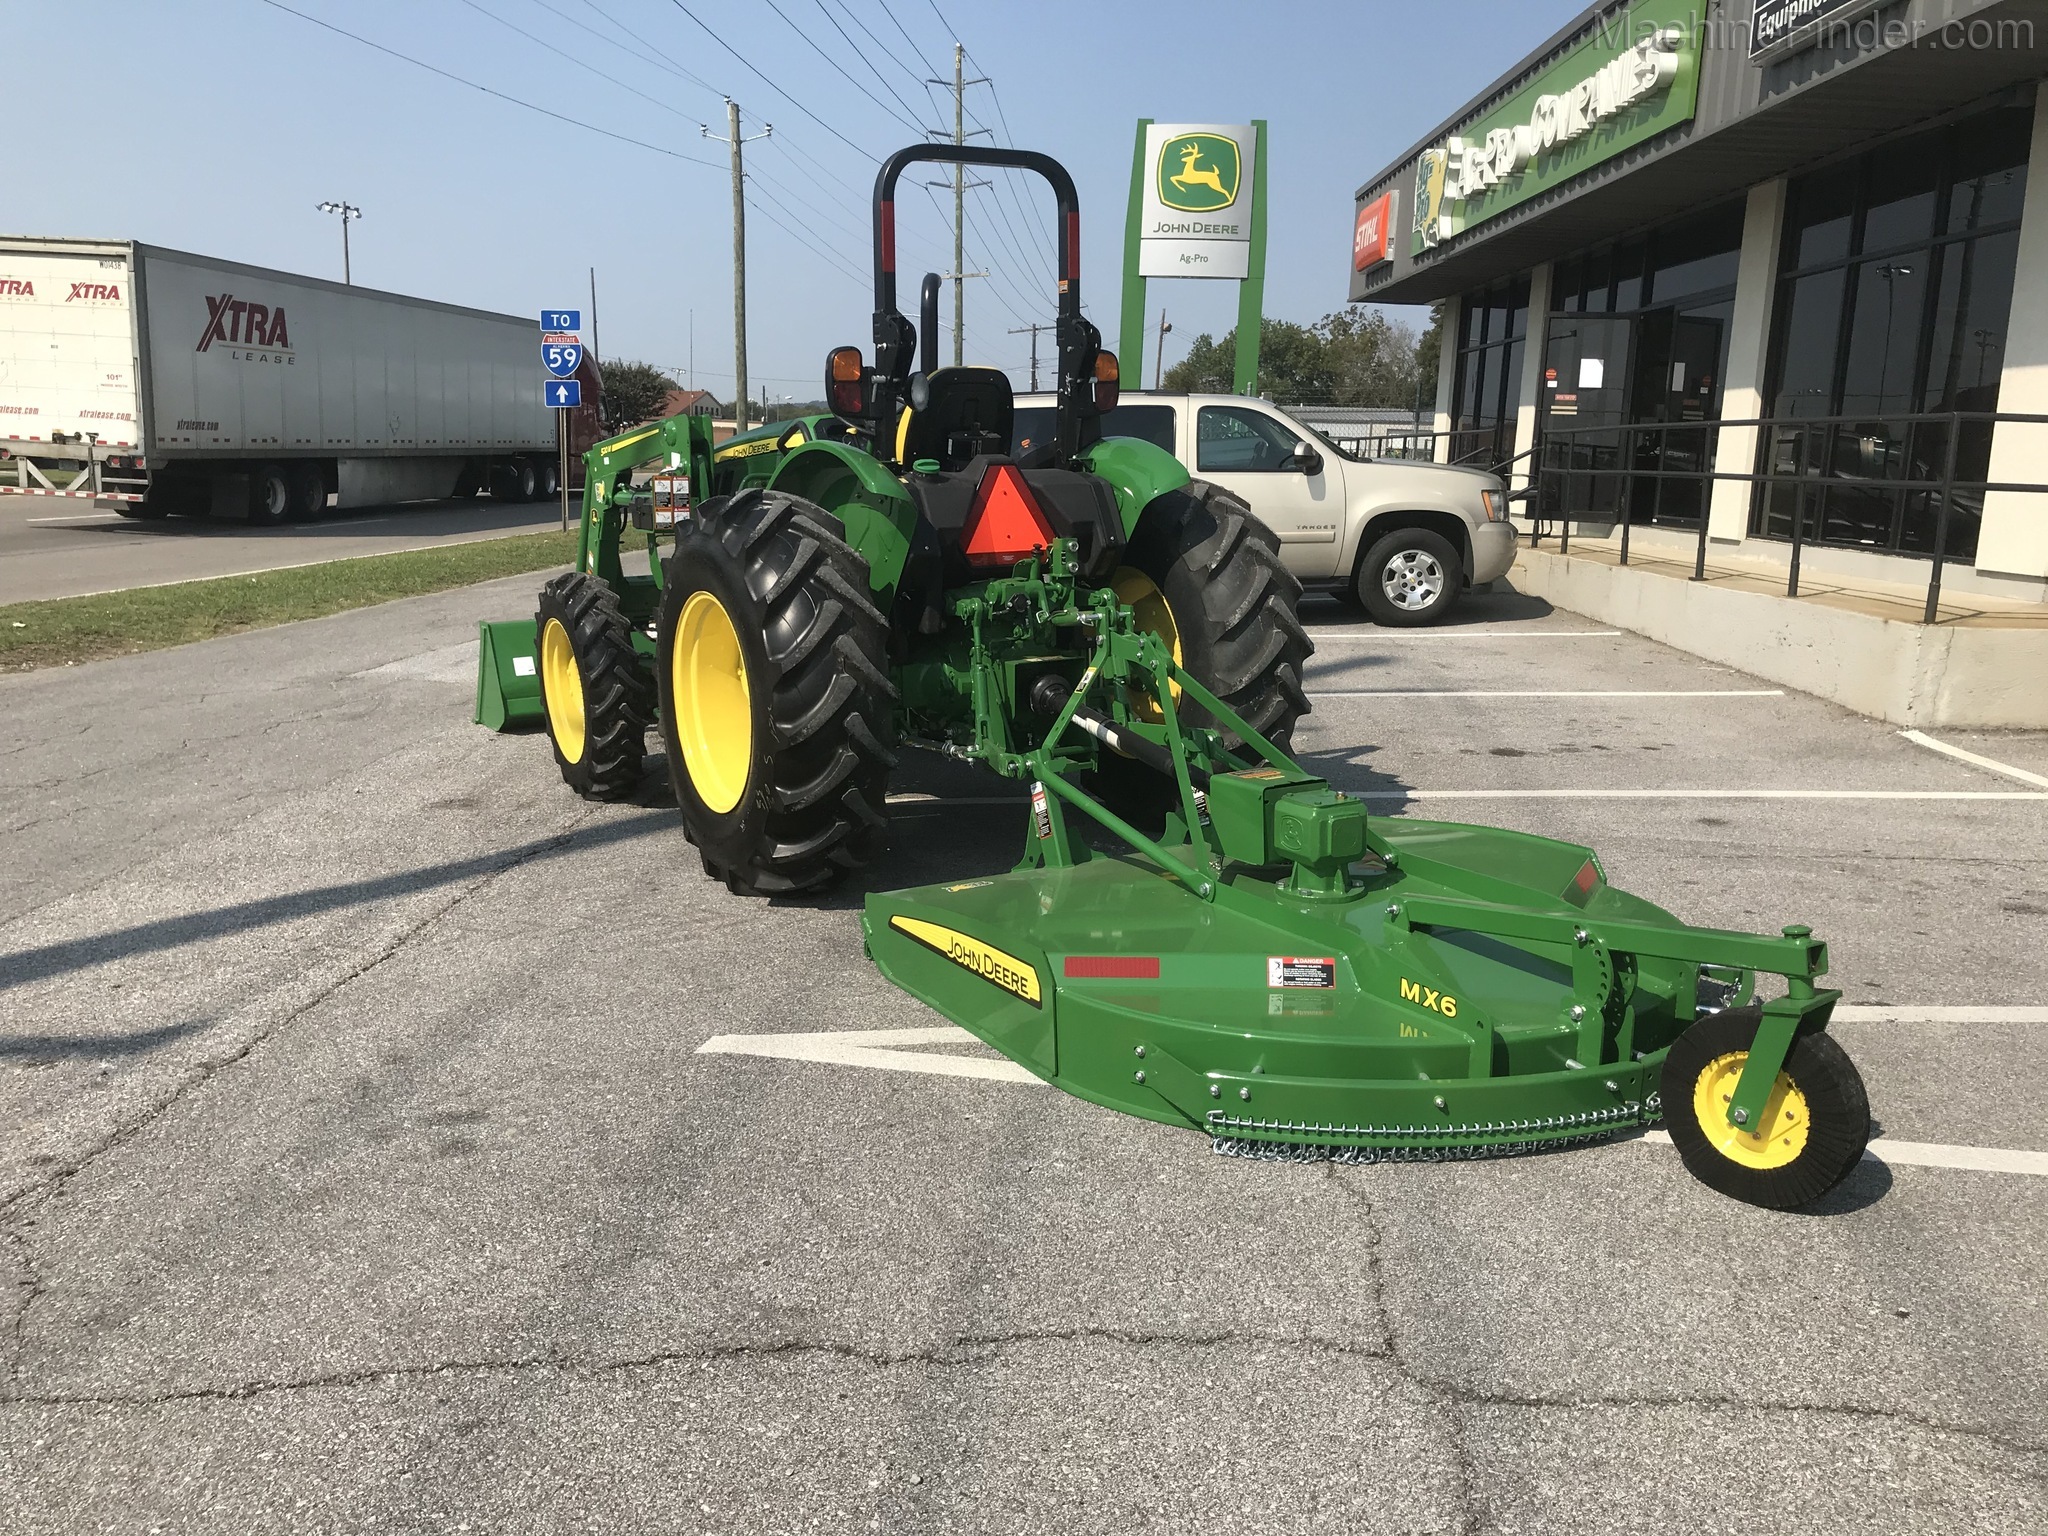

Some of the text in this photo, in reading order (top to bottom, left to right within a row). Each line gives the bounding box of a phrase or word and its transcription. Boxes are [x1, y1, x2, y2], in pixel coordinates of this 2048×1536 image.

[1757, 0, 1826, 40] Equipm
[1153, 221, 1239, 235] JOHN DEERE
[1355, 214, 1379, 253] STIHL
[1179, 253, 1209, 264] Ag-Pro
[0, 279, 35, 296] TRA
[65, 282, 120, 302] XTRA
[196, 293, 289, 352] XTRA
[550, 314, 571, 327] TO
[232, 351, 295, 365] LEASE
[549, 348, 577, 368] 59
[79, 409, 131, 421] xtralease.com
[176, 418, 219, 431] xtralease.com
[733, 443, 770, 458] JOHN DEERE
[947, 936, 1029, 996] JOHN DEERE
[1400, 976, 1458, 1018] MX6
